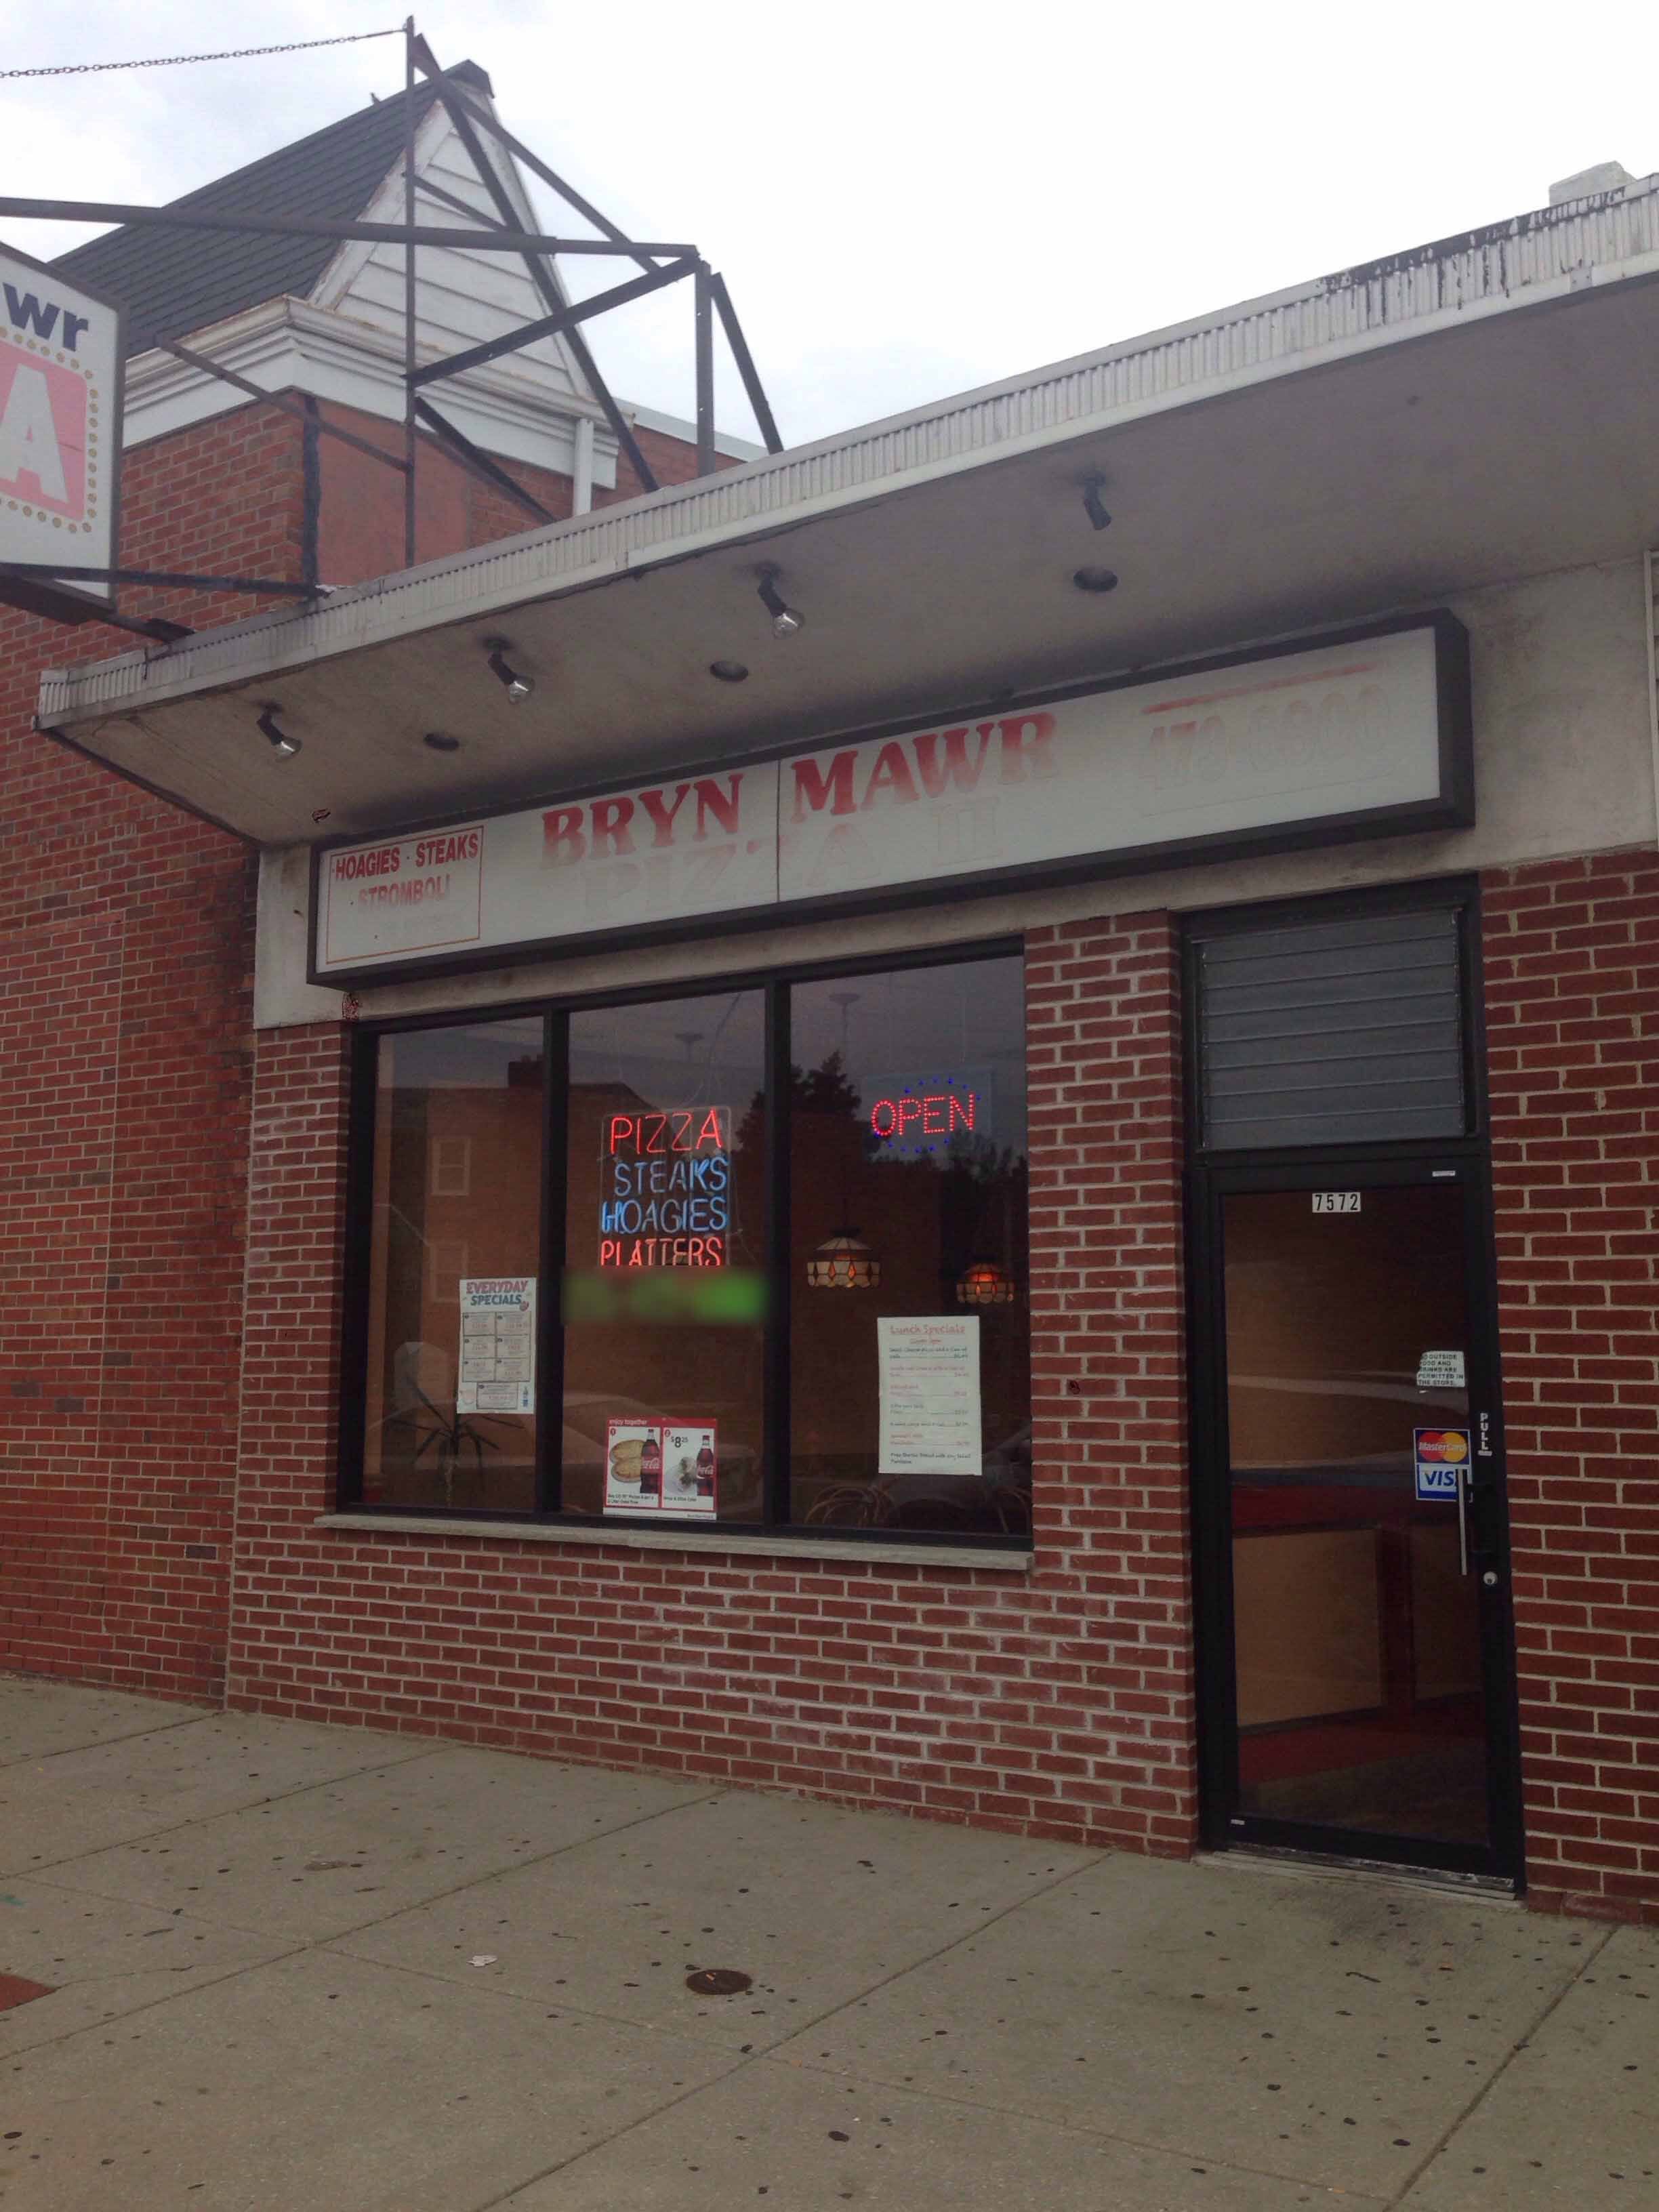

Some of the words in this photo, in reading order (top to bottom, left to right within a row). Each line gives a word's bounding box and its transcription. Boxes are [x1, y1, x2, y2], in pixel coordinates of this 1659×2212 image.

[0, 363, 69, 502] A
[541, 773, 744, 869] BRYN
[790, 711, 1059, 823] MAWR
[335, 847, 401, 880] HOAGIES
[415, 833, 478, 867] STEAKS
[611, 1107, 723, 1155] PIZZA
[870, 1092, 975, 1138] OPEN
[614, 1154, 729, 1197] STEAKS
[601, 1195, 727, 1235] HOAGIES
[1315, 1193, 1359, 1212] 7572
[600, 1236, 722, 1266] PLATTERS
[466, 1280, 529, 1294] EVERYDAY
[470, 1294, 522, 1306] SPECIALS
[889, 1324, 922, 1334] Lunch
[924, 1323, 966, 1336] Specials
[1418, 1441, 1467, 1452] MasterCard
[1479, 1412, 1489, 1450] PULL
[1425, 1471, 1457, 1486] VIS
